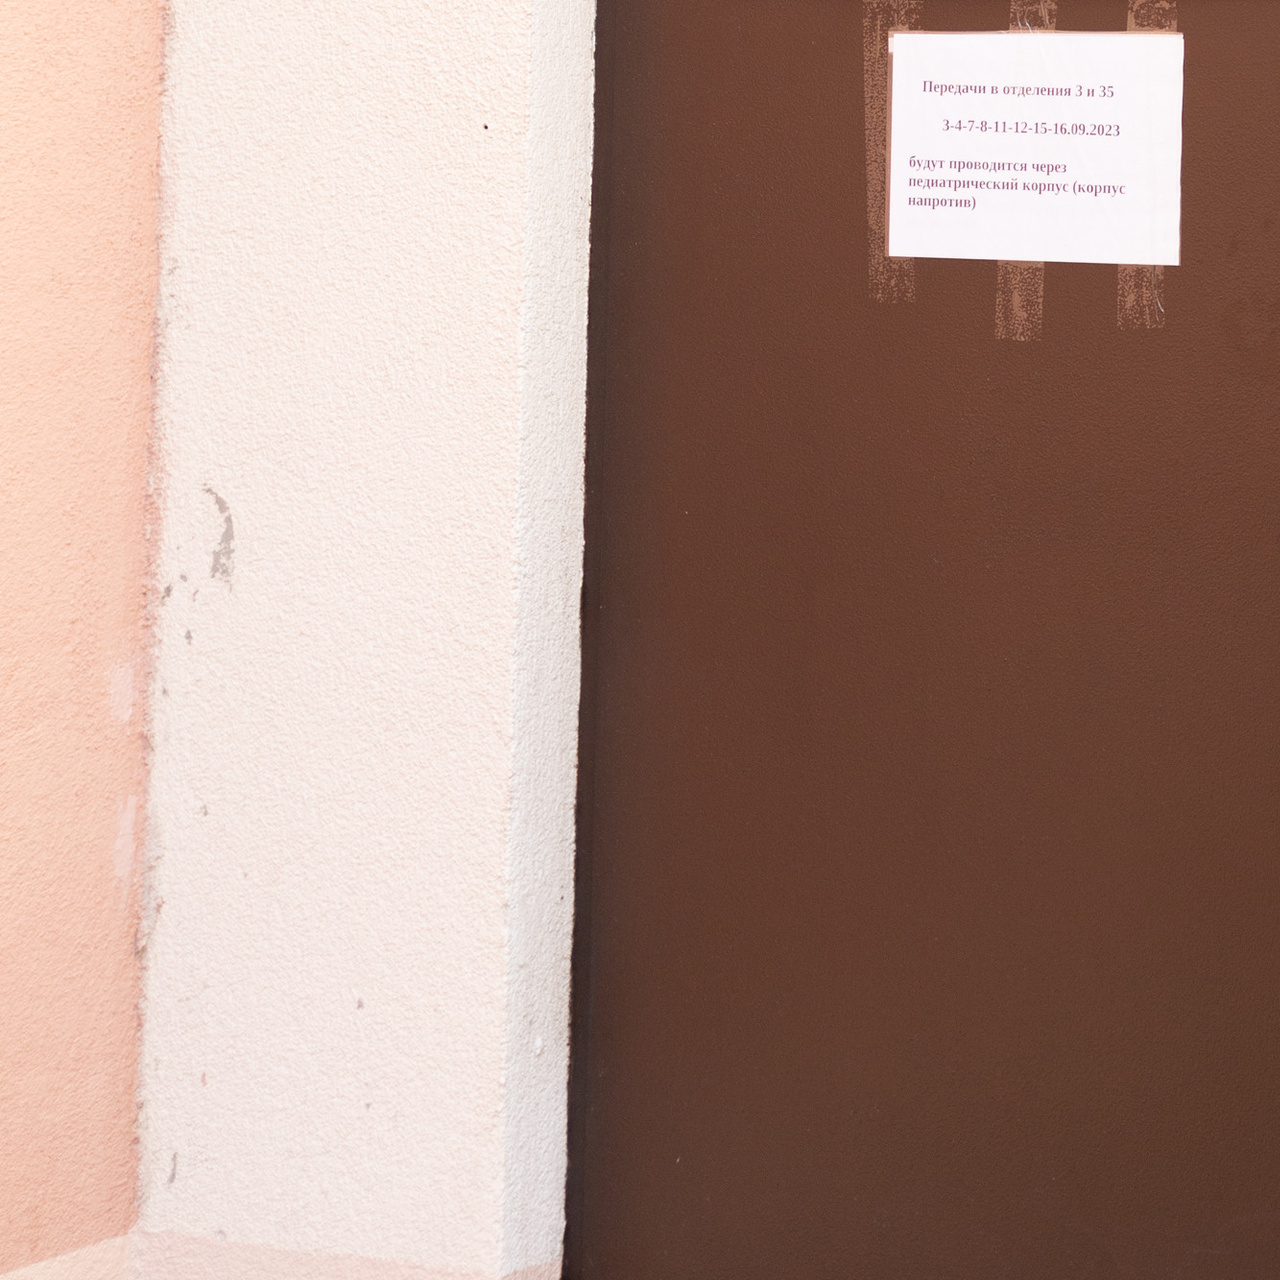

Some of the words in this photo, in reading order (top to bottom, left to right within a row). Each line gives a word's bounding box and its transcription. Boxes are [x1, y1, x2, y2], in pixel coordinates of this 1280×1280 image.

[922, 80, 987, 97] Передачи
[990, 85, 999, 95] в
[1002, 84, 1072, 98] отделения
[1075, 84, 1083, 97] 3
[1086, 87, 1095, 98] и
[1098, 84, 1115, 98] 35
[942, 118, 1121, 137] 3-4-7-8-11-12-15-16.09.2023
[908, 155, 946, 172] будут
[949, 160, 1028, 174] проводится
[1031, 162, 1068, 177] через
[908, 176, 1019, 192] педиатрический
[1022, 181, 1069, 196] корпус
[1072, 180, 1126, 197] (корпус
[907, 195, 977, 212] напротив)
